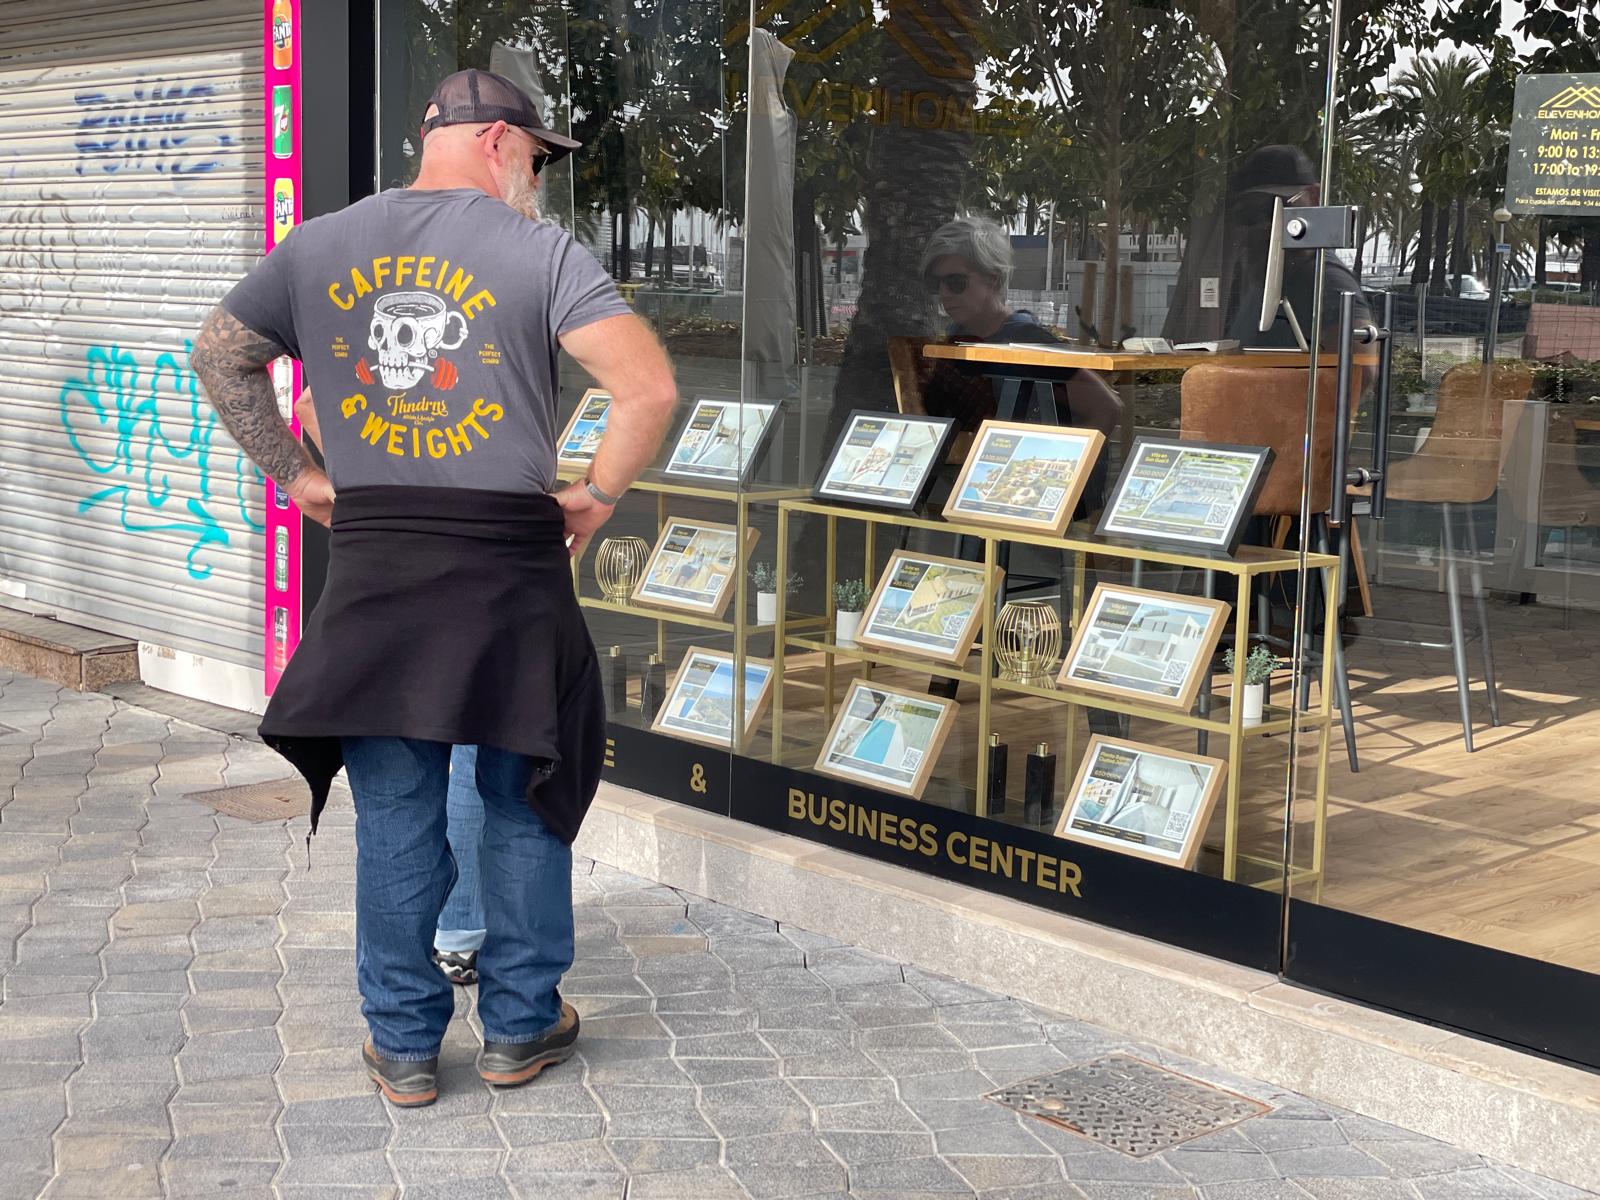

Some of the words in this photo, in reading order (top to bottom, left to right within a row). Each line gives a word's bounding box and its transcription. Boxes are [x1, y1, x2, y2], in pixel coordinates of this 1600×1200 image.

[1550, 128, 1578, 140] Mon
[1537, 145, 1563, 158] 9:00
[1565, 145, 1578, 158] to
[1533, 163, 1564, 175] 17:00
[1567, 163, 1580, 176] to
[1535, 187, 1569, 196] ESTAMOS
[1570, 189, 1581, 197] DE
[328, 256, 497, 320] CAFFEINE
[341, 393, 367, 419] &
[360, 398, 504, 459] WEIGHTS
[690, 763, 707, 793] &
[788, 788, 939, 857] BUSINESS
[946, 831, 1083, 898] CENTER
